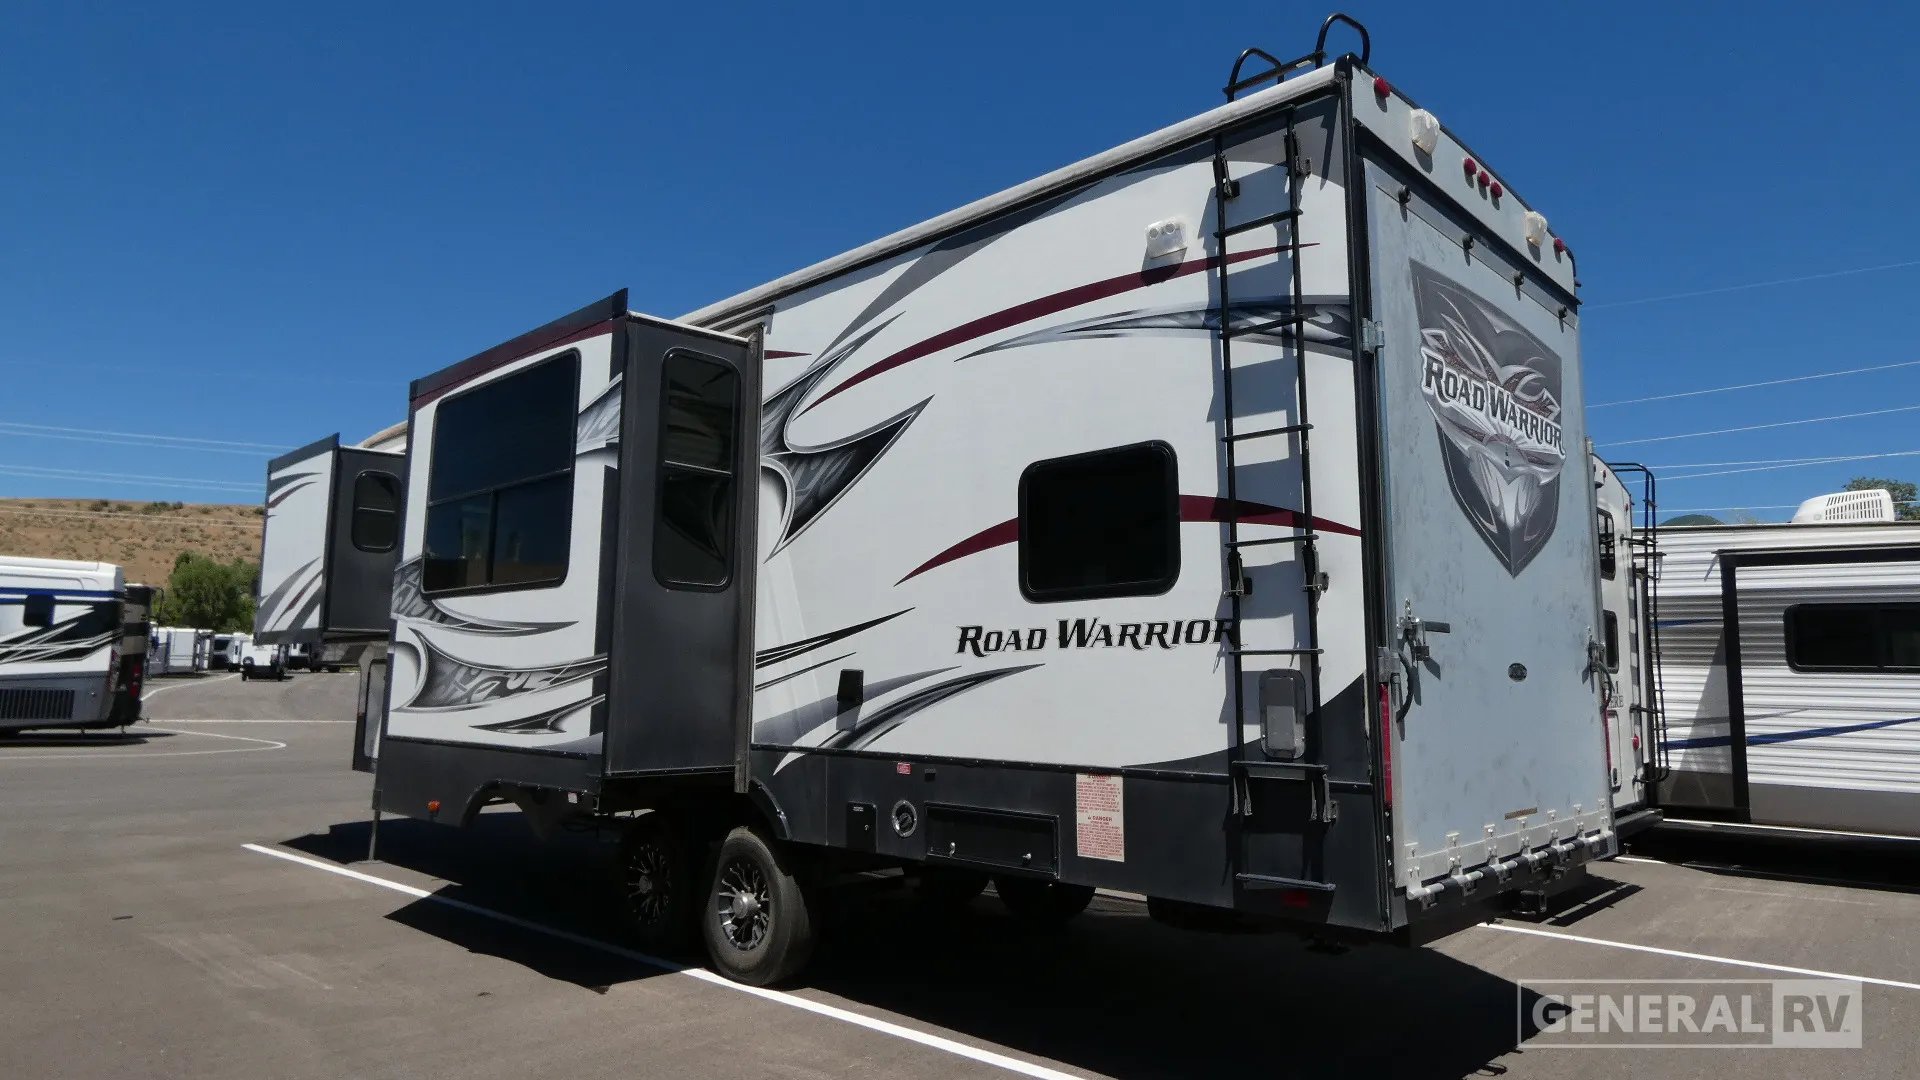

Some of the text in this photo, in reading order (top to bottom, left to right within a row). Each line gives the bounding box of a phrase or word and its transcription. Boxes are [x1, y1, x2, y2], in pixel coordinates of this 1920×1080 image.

[1422, 350, 1564, 456] ROAD WARRIOR
[956, 617, 1244, 657] ROAD WARRIOR
